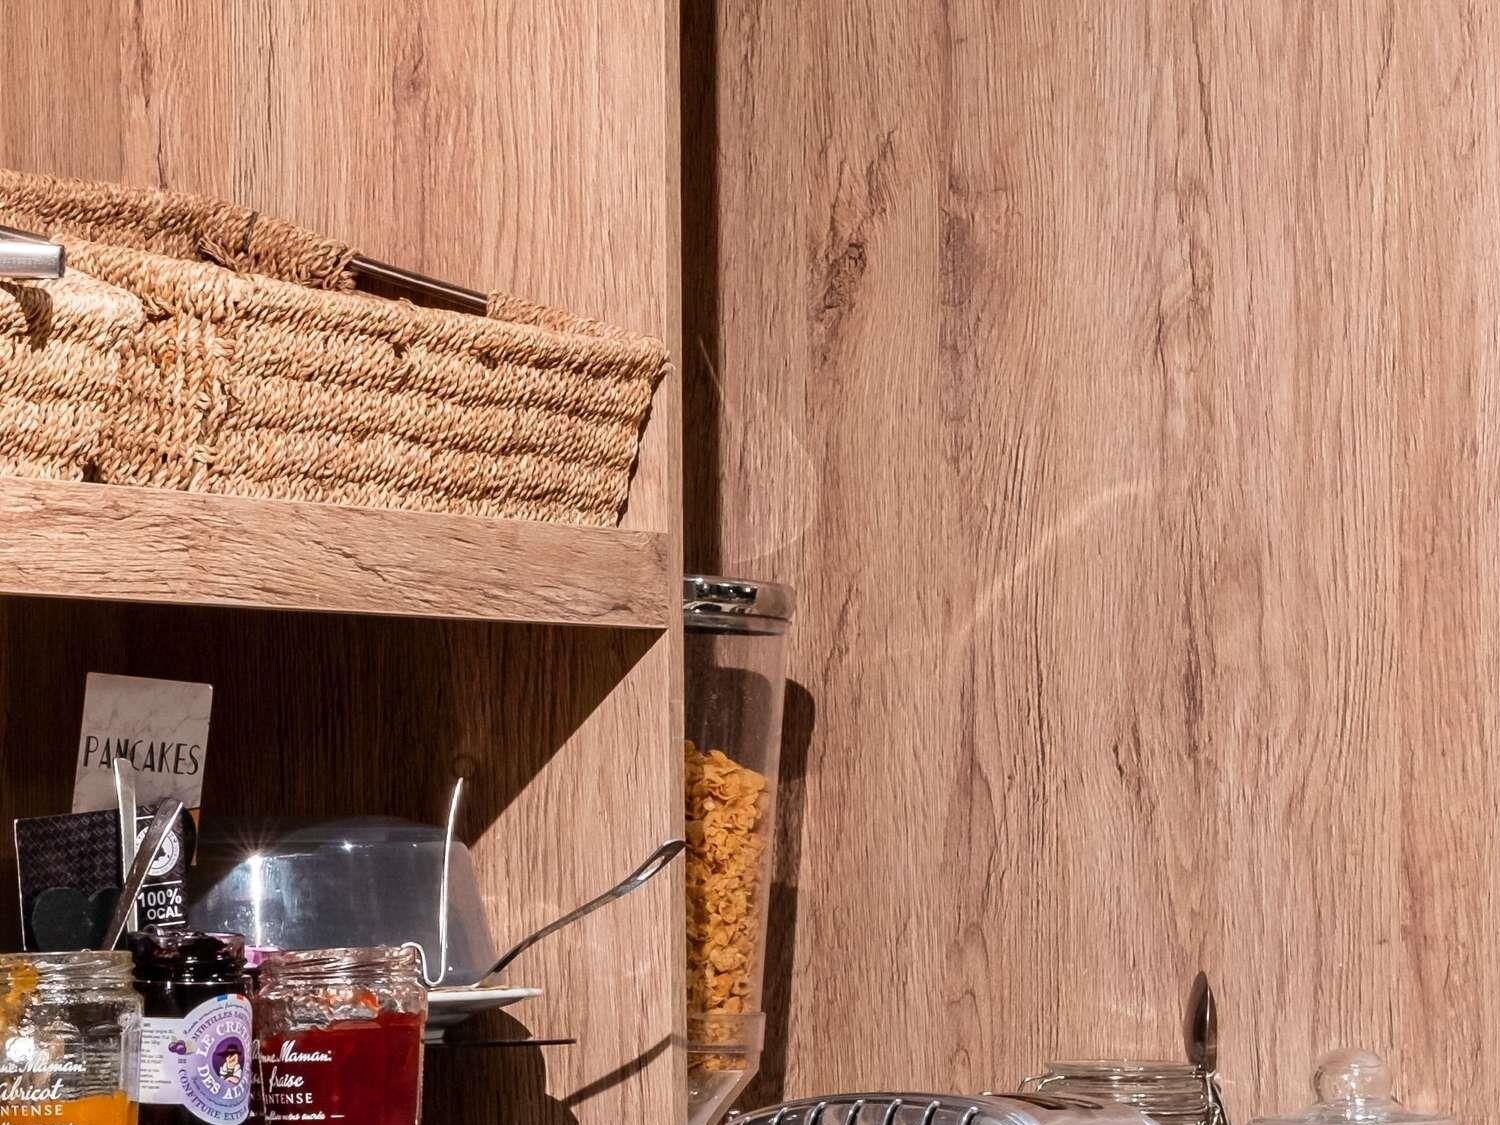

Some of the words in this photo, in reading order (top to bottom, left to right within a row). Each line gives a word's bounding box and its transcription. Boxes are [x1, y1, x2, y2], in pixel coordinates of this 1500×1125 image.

[82, 735, 201, 776] PANCAKES
[137, 887, 183, 909] 100%
[146, 905, 184, 921] OCAL
[0, 1104, 64, 1117] NTENSE
